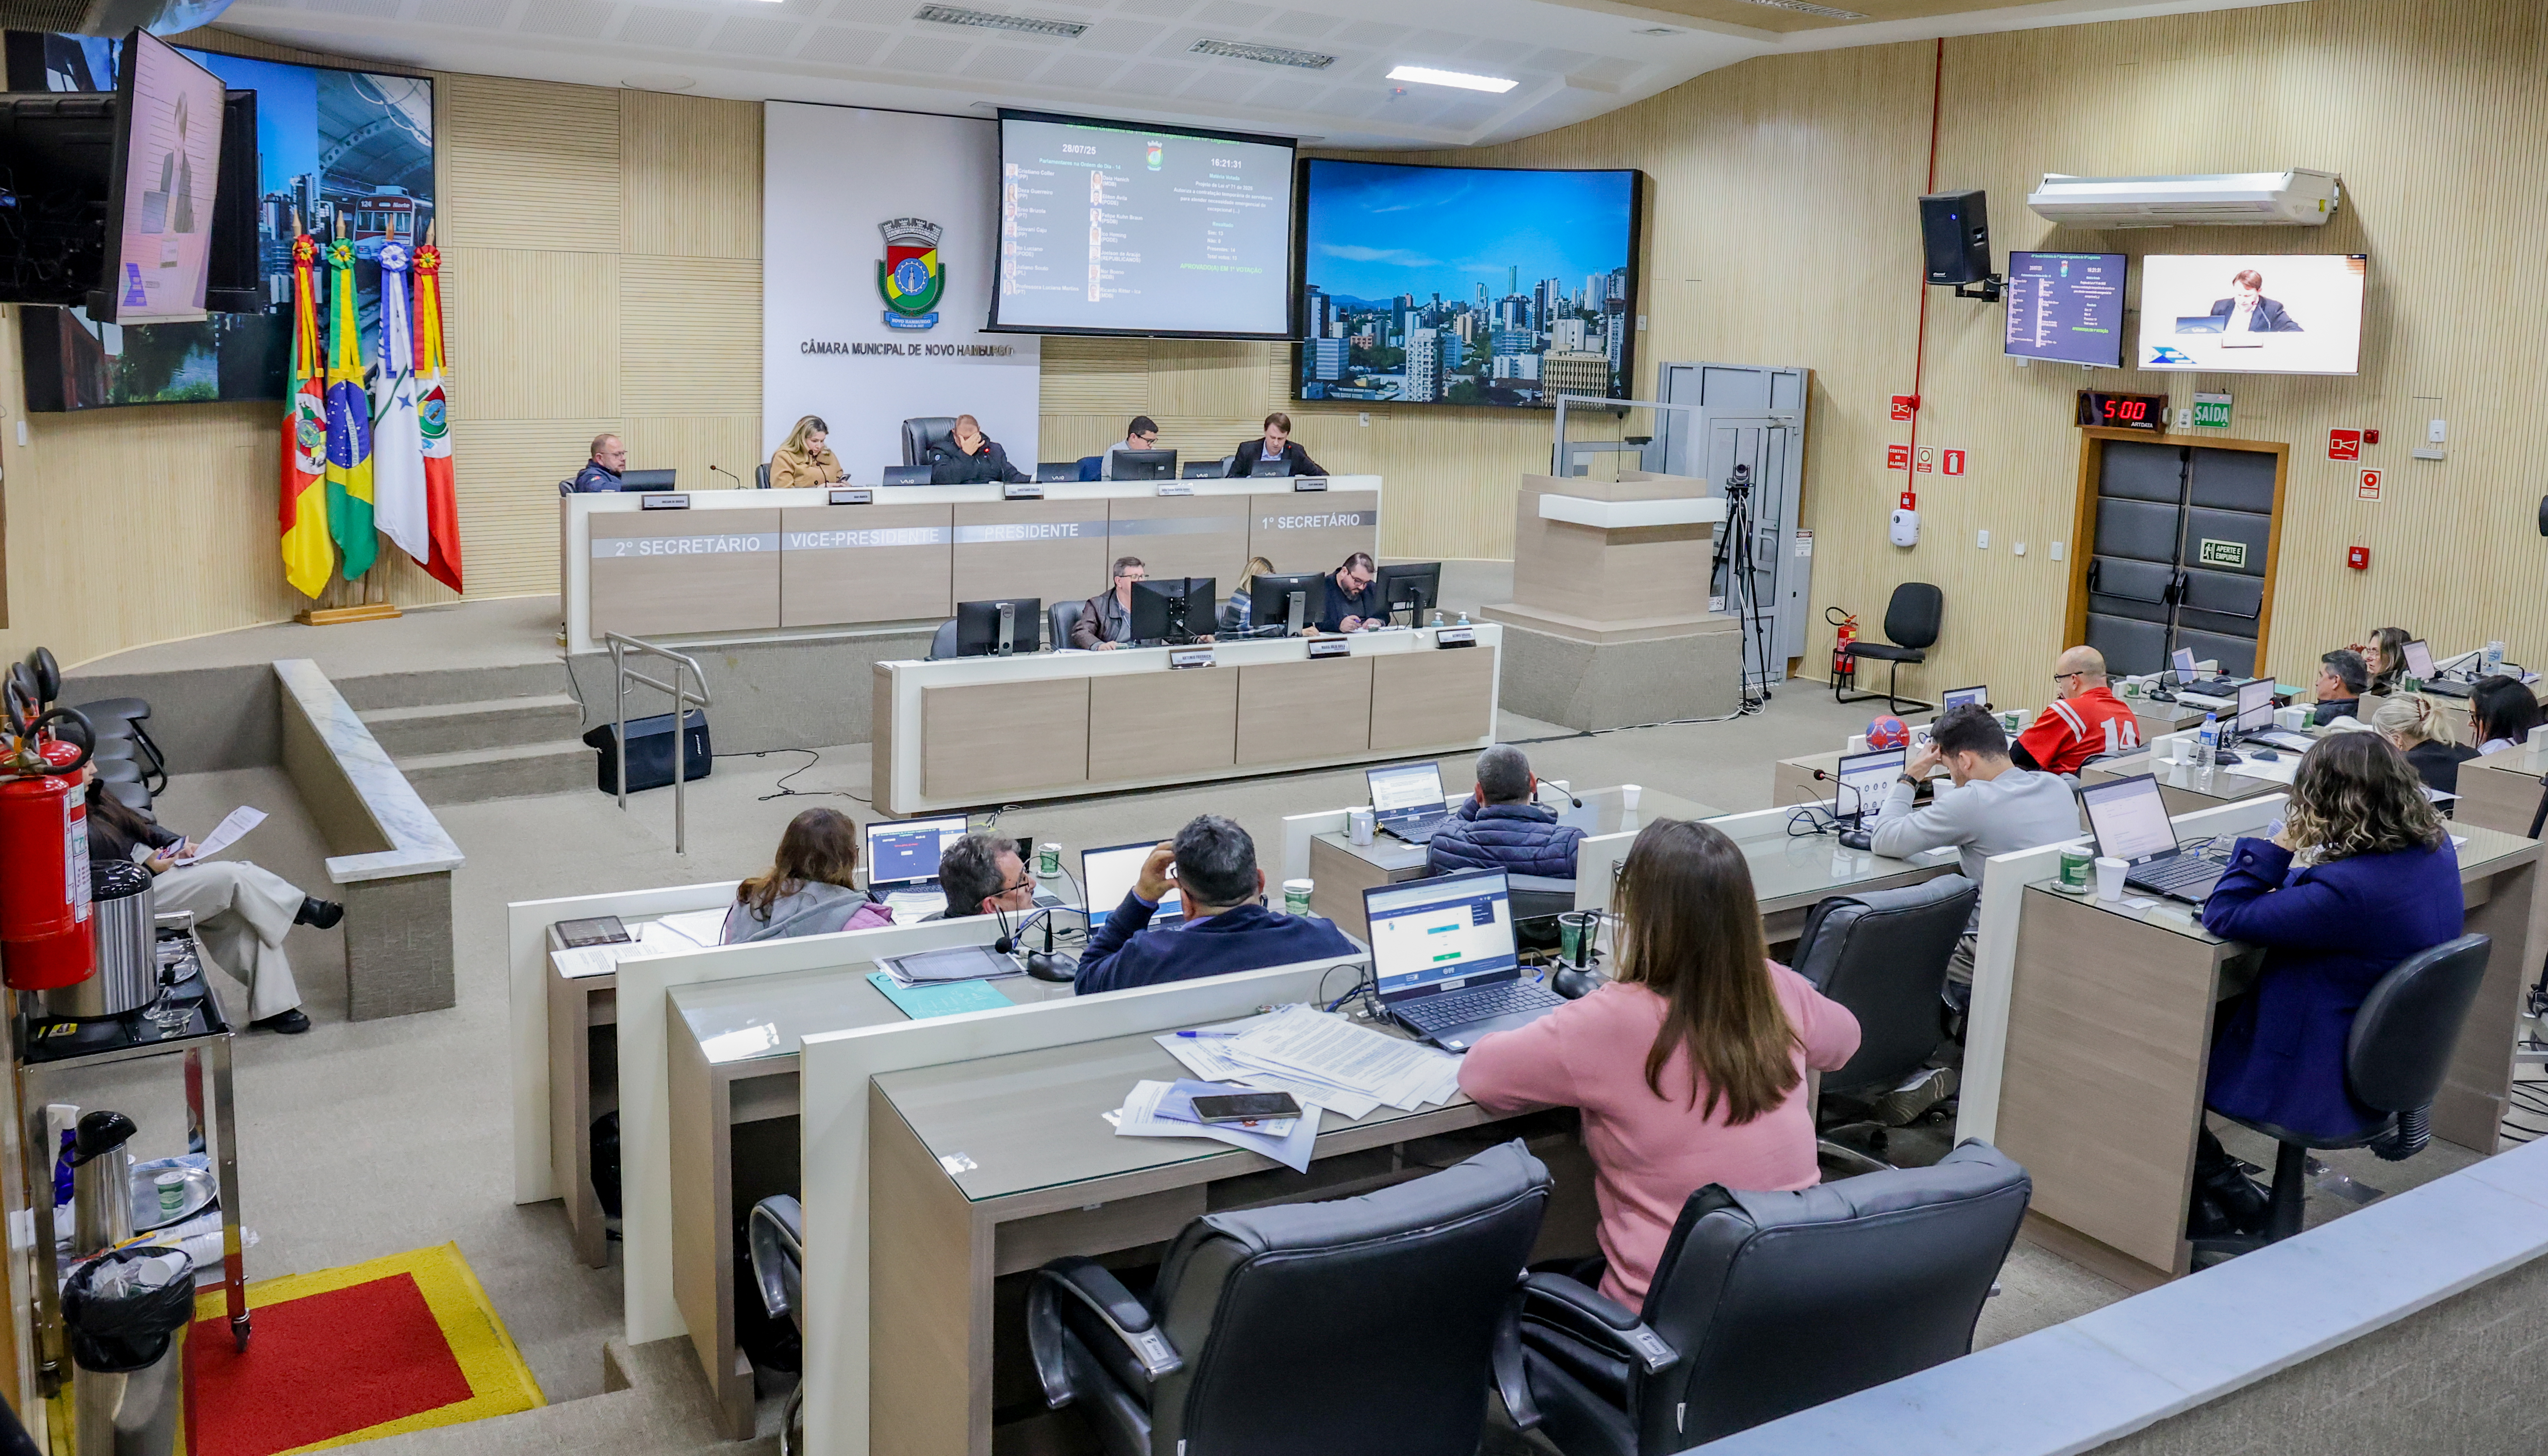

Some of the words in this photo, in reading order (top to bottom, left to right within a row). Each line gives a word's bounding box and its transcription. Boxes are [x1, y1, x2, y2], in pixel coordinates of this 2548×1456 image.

[1062, 144, 1096, 155] 28/07/25
[1211, 158, 1241, 168] 16:21:31
[800, 339, 849, 355] CÂMARA
[852, 343, 905, 356] MUNICIPAL
[909, 344, 921, 356] DE
[926, 344, 955, 356] NOVO
[957, 345, 1015, 357] HAMBURGO
[2195, 403, 2228, 423] SAÍDA
[1277, 512, 1360, 529] SECRETÁRIO
[791, 529, 939, 547] VICE-PRESIDENTE
[985, 523, 1079, 540] PRESIDENTE
[639, 535, 760, 555] SECRETÁRIO
[2216, 545, 2237, 554] APERTE
[2215, 552, 2240, 562] EMPURRE
[2100, 717, 2137, 752] 14
